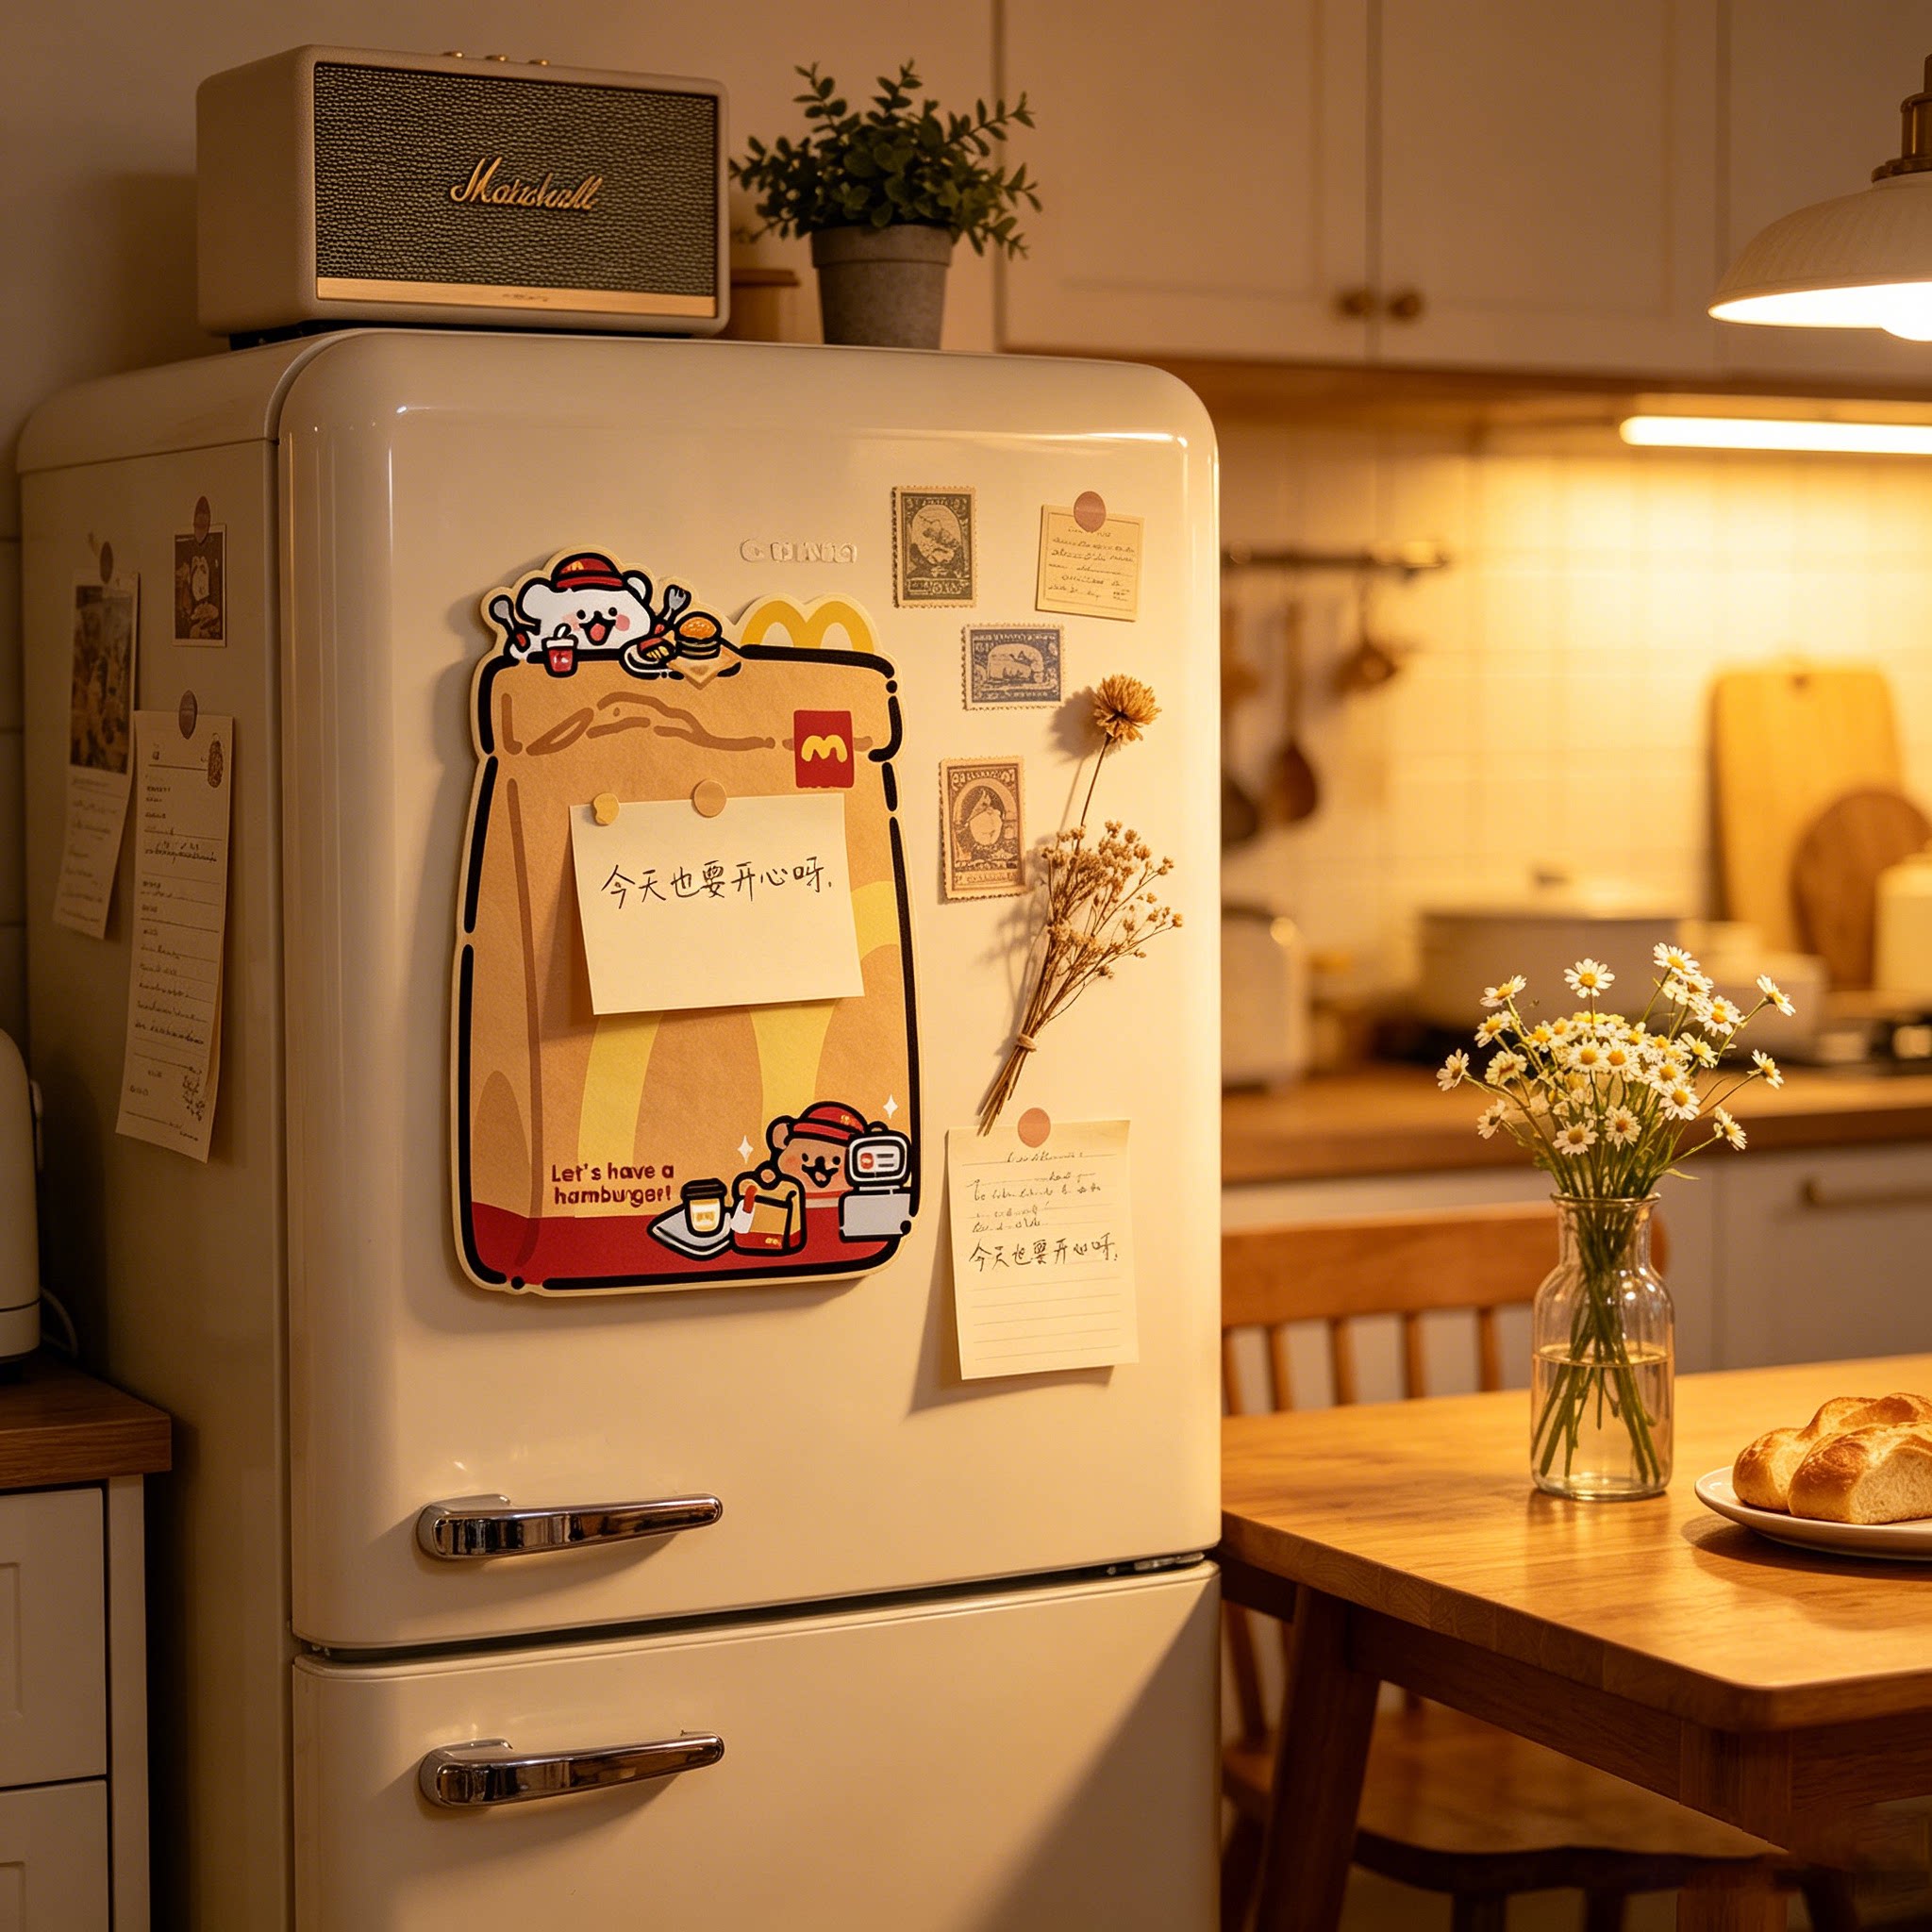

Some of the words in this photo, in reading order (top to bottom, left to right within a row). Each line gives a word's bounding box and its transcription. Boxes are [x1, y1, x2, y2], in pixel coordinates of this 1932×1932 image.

[552, 1162, 602, 1182] Let's
[608, 1161, 656, 1180] have
[661, 1164, 675, 1179] a
